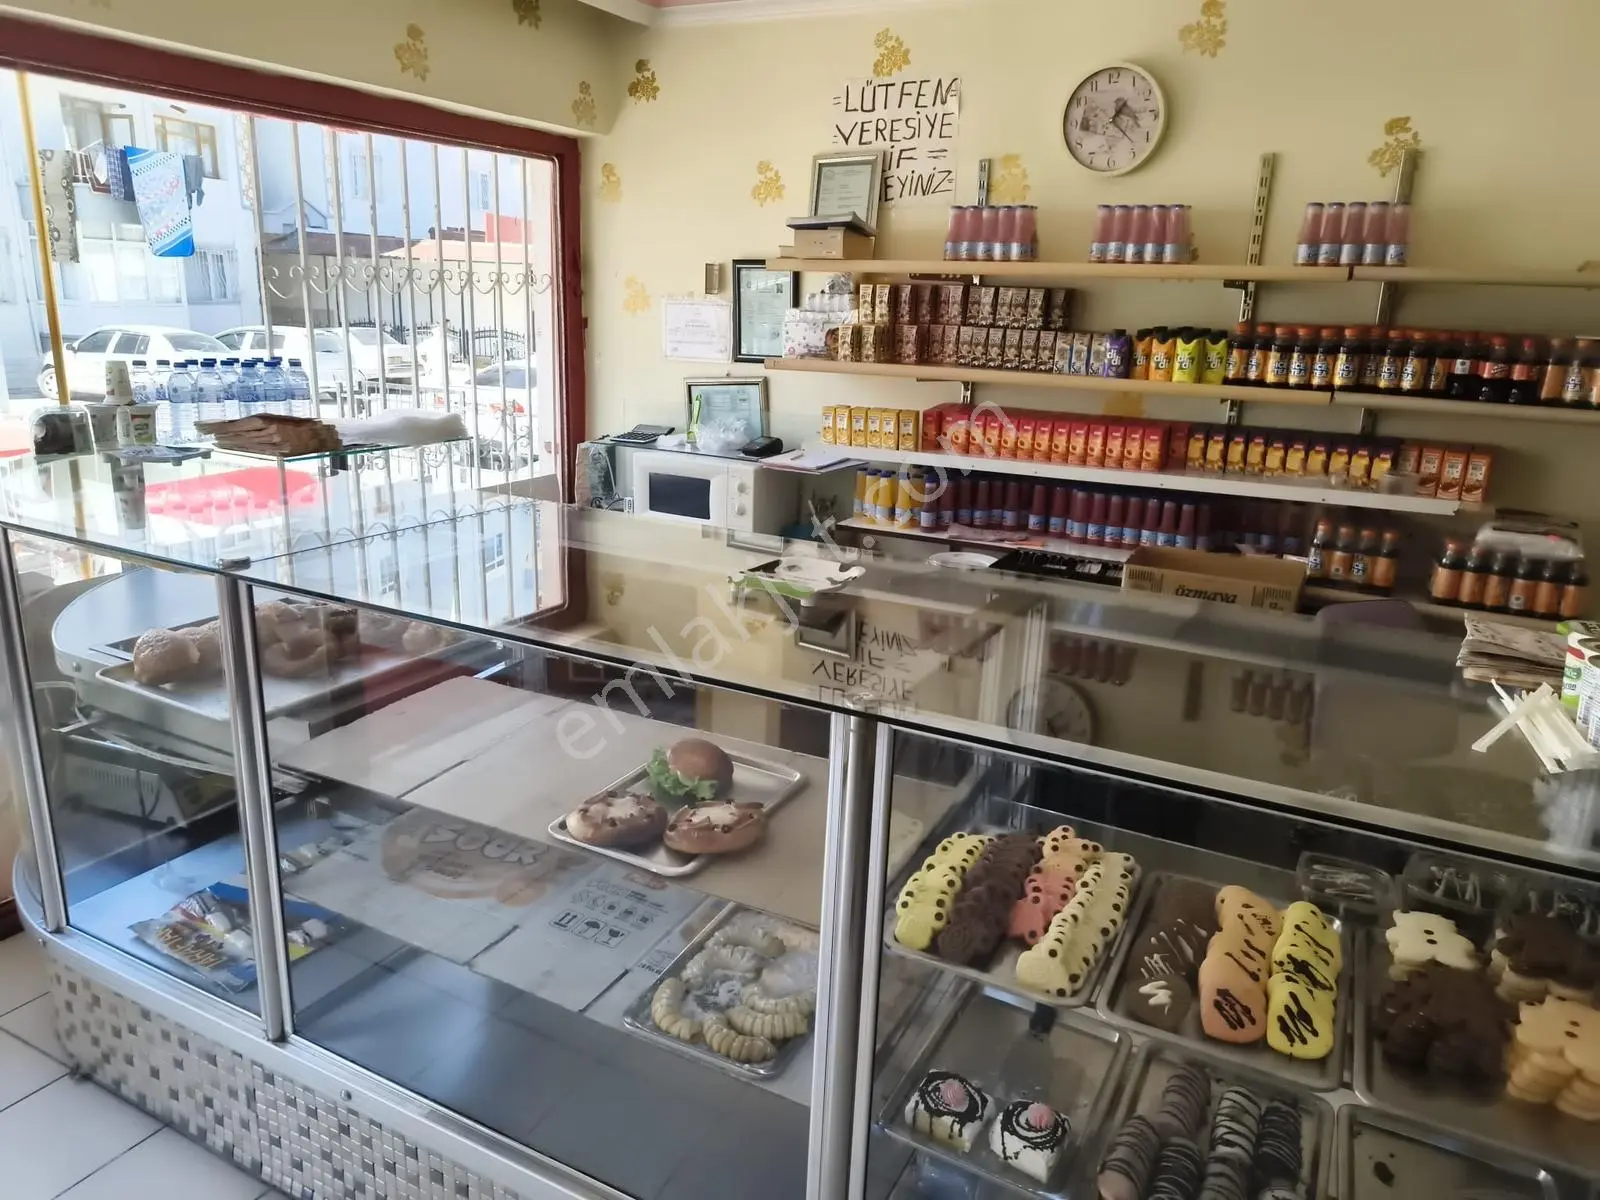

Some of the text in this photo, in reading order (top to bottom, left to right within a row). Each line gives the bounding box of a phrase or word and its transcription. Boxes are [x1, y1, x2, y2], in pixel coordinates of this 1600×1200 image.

[1090, 80, 1098, 92] 11
[1108, 71, 1121, 84] 12
[844, 78, 959, 113] LÜTFEN
[1076, 96, 1088, 108] 10
[835, 111, 955, 146] VERESİYE
[879, 166, 954, 202] EYİNİZ
